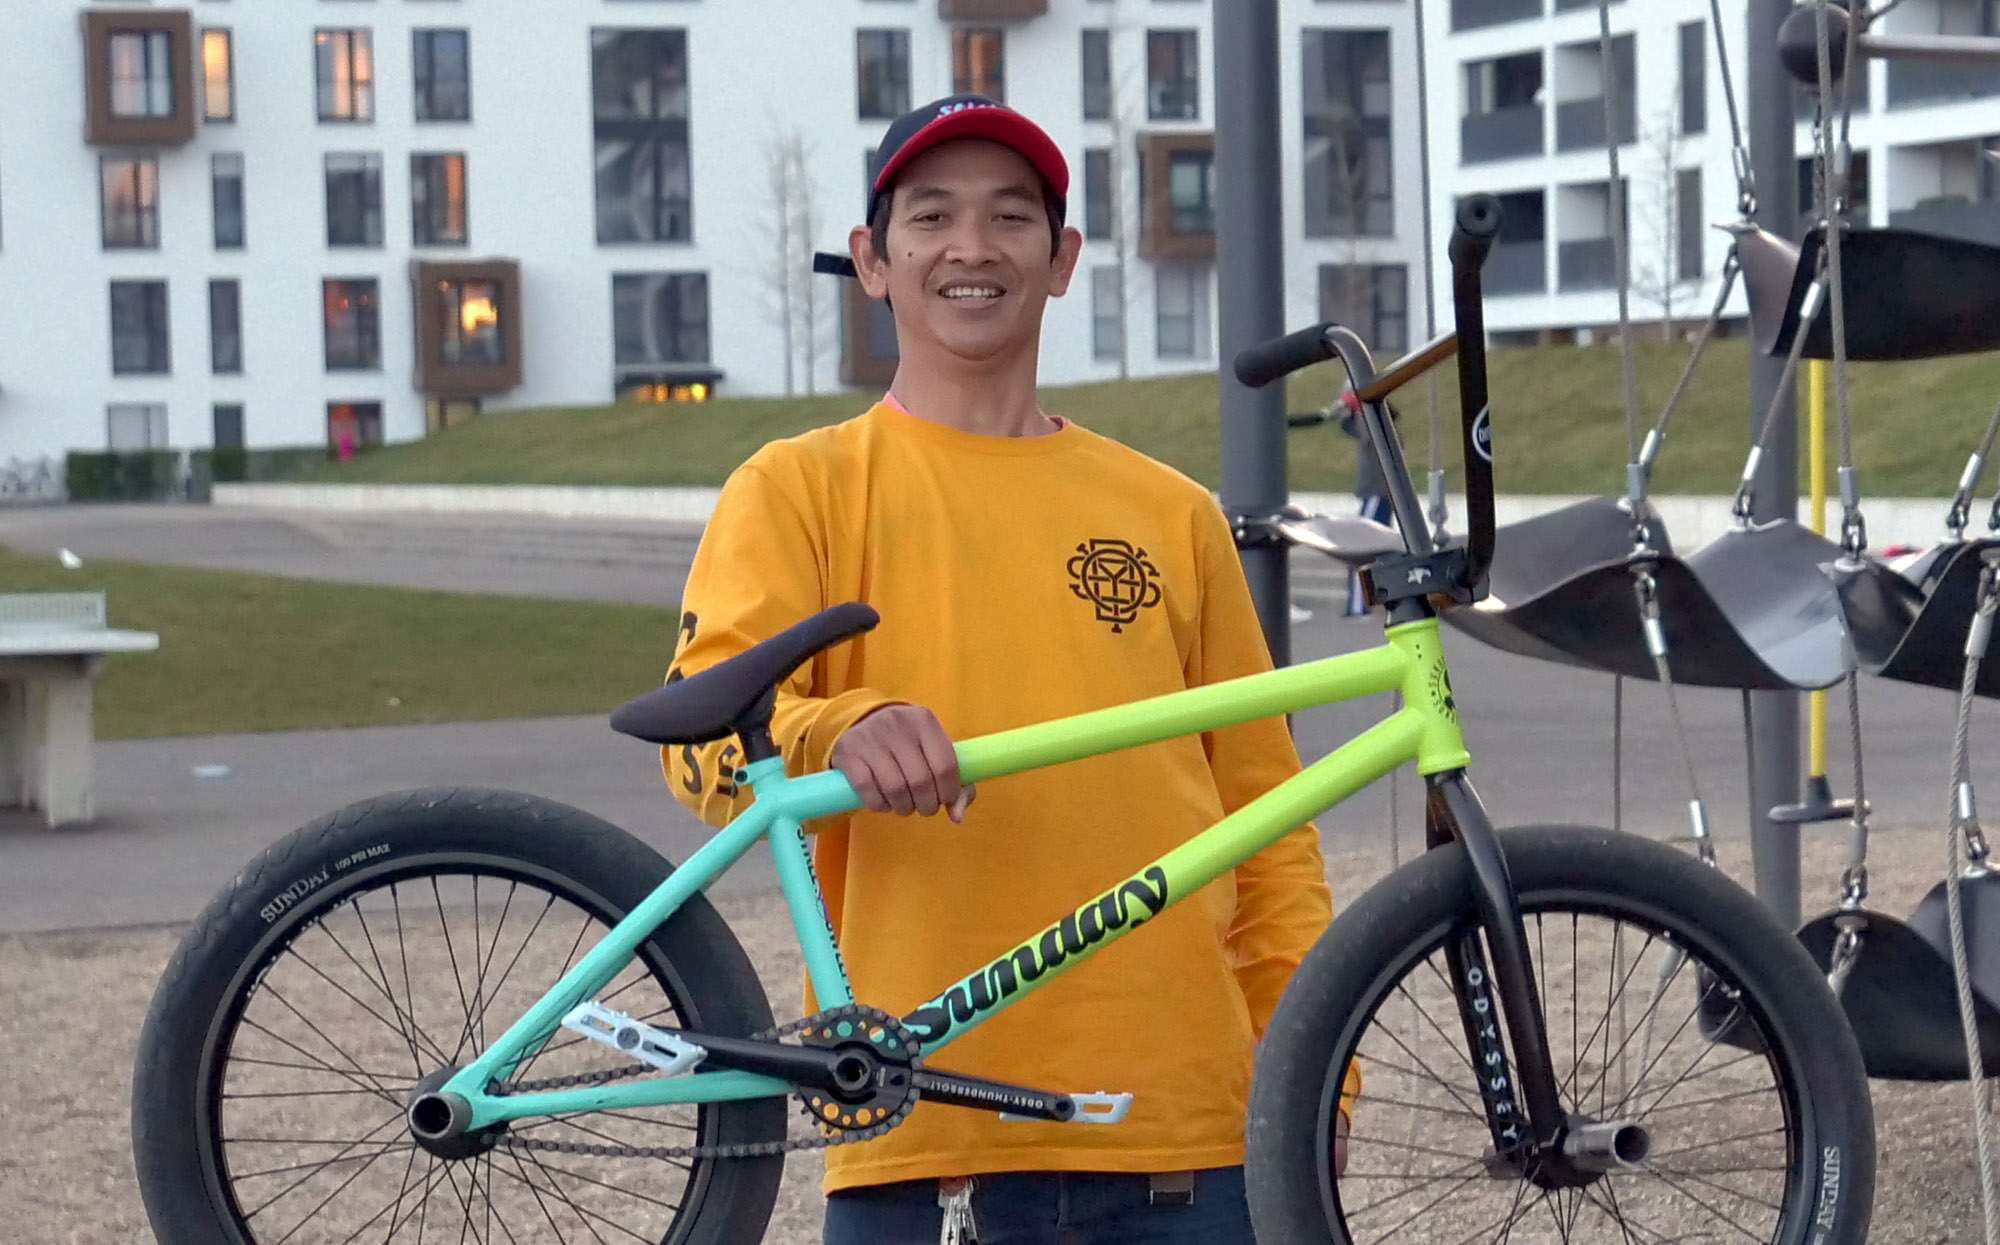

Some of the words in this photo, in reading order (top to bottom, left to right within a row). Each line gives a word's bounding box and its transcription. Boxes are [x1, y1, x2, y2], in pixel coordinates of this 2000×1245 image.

[260, 864, 330, 923] SUNDAY
[366, 843, 391, 858] MAX
[901, 865, 1168, 1044] sunday
[1467, 966, 1518, 1140] ODYSSEY
[1816, 1145, 1840, 1231] SUNDAY
